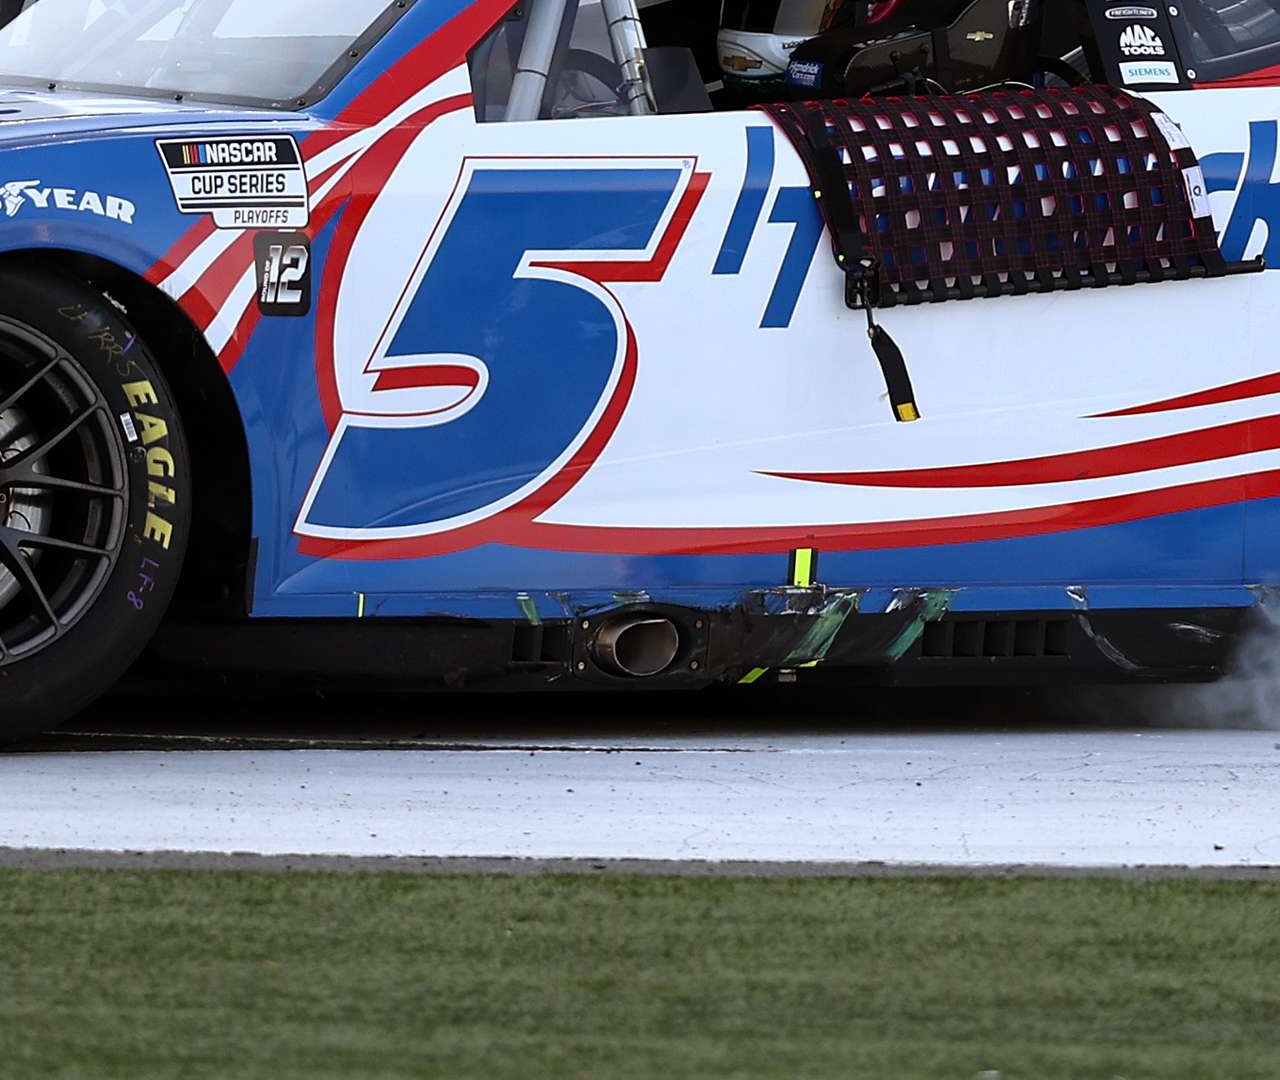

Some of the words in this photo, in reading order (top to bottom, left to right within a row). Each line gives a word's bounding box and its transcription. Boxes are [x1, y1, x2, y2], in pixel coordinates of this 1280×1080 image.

[1120, 24, 1163, 48] MAC
[1121, 47, 1165, 56] TOOLS
[1128, 67, 1171, 78] SIEMENS
[204, 142, 277, 163] NASCAR
[191, 174, 224, 195] CUP
[227, 173, 286, 194] SERIES
[234, 210, 289, 224] PLAYOFFS
[267, 245, 308, 302] 12
[295, 156, 710, 548] 5
[121, 379, 177, 550] EAGLE
